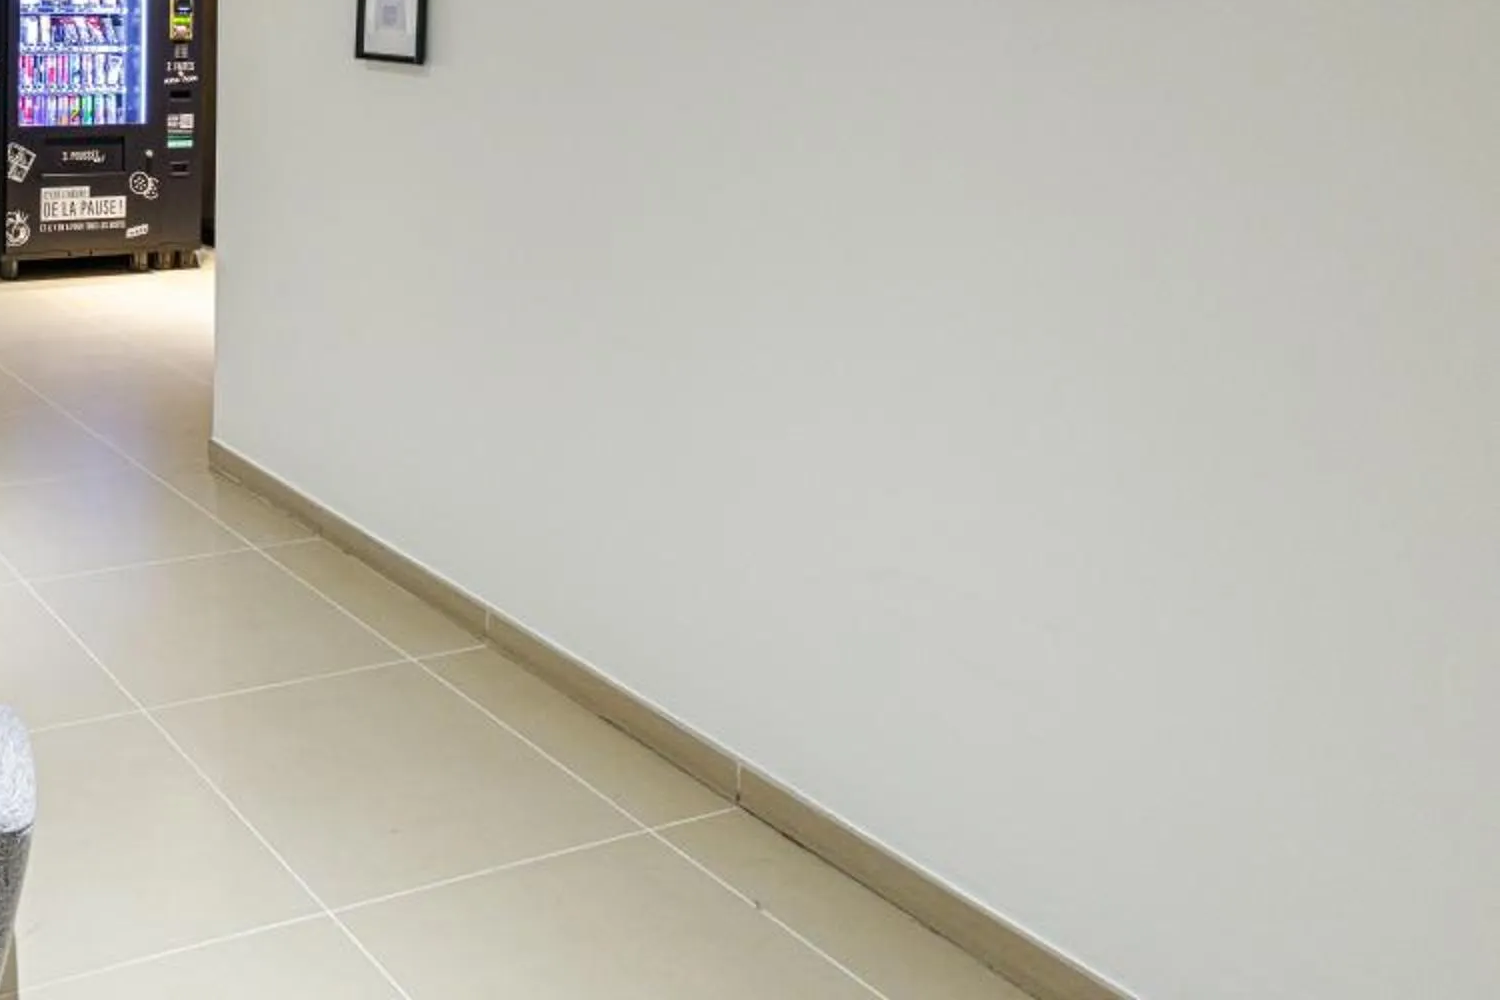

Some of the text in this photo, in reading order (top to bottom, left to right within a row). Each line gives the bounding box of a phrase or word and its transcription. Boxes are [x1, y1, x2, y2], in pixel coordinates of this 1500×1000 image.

[43, 201, 59, 218] DE
[62, 200, 77, 217] LA
[81, 199, 117, 216] PAUSE
